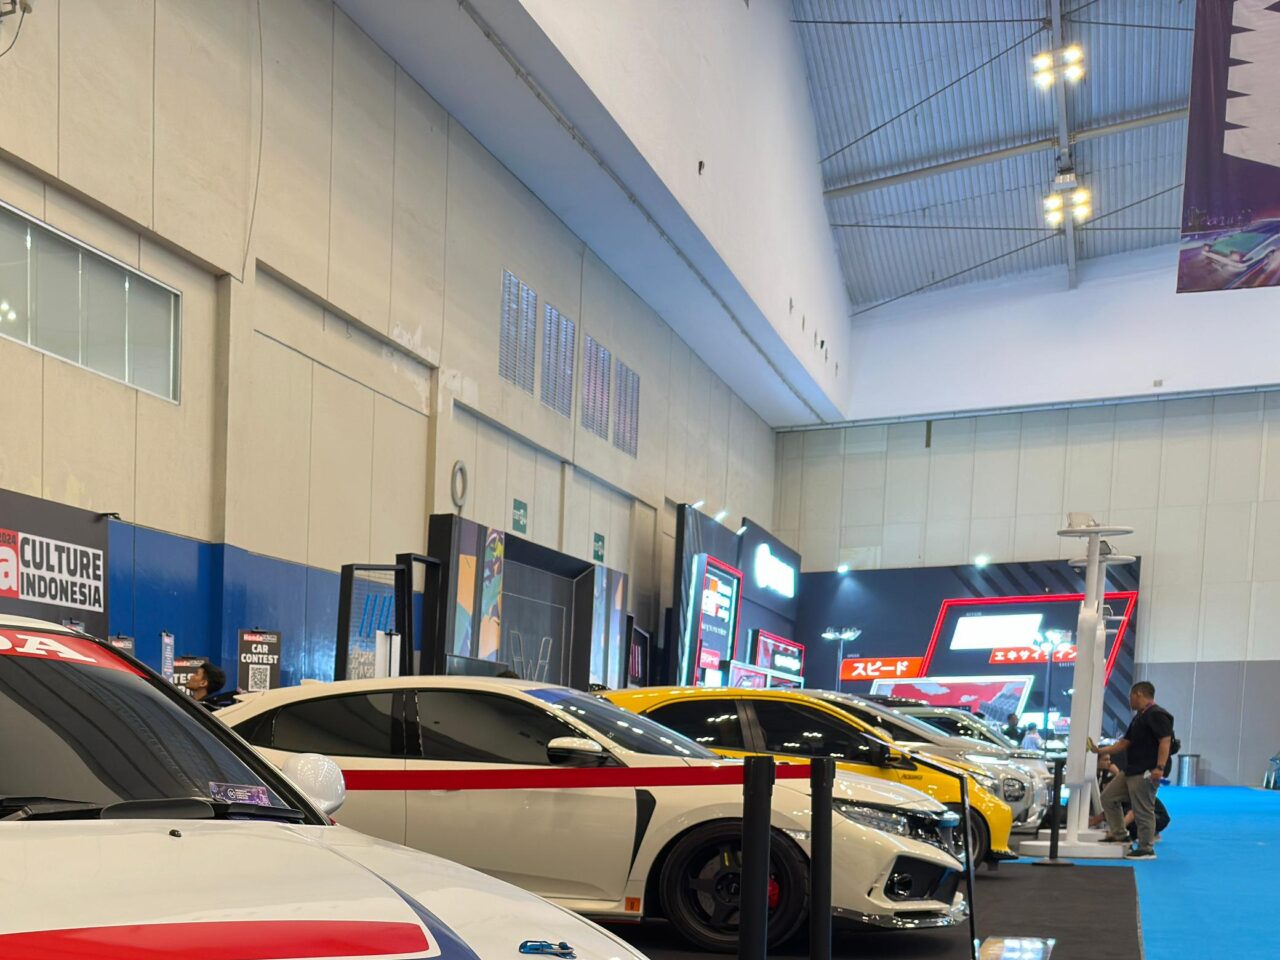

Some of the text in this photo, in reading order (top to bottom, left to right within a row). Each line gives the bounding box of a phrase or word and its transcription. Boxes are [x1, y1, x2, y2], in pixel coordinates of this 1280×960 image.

[20, 536, 102, 582] CULTURE
[20, 571, 103, 608] INDONESIA
[240, 653, 279, 664] CONTEST
[251, 643, 269, 654] CAR
